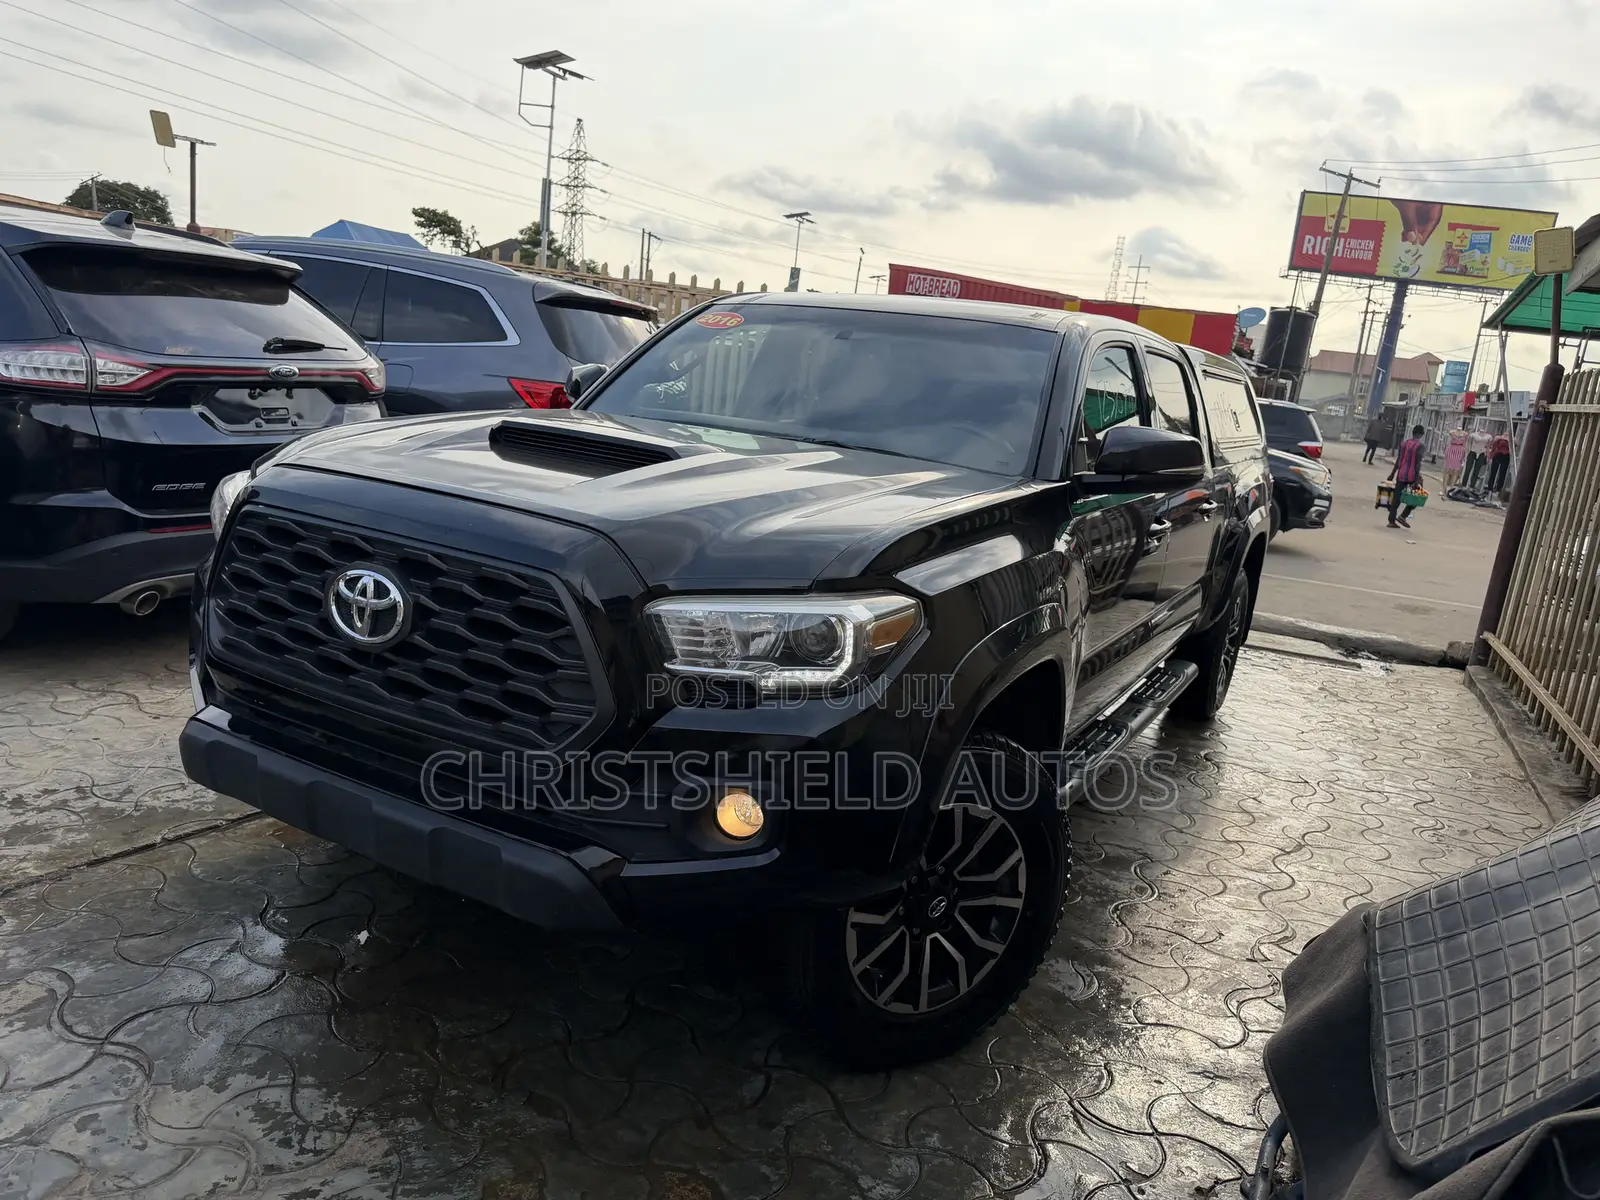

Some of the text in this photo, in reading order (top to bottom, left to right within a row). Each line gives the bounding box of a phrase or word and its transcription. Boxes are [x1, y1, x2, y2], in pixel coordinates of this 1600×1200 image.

[1345, 238, 1375, 252] CHICKEN
[1343, 249, 1373, 261] FLAVOUR
[697, 314, 742, 326] 2016
[151, 482, 206, 491] EDGE
